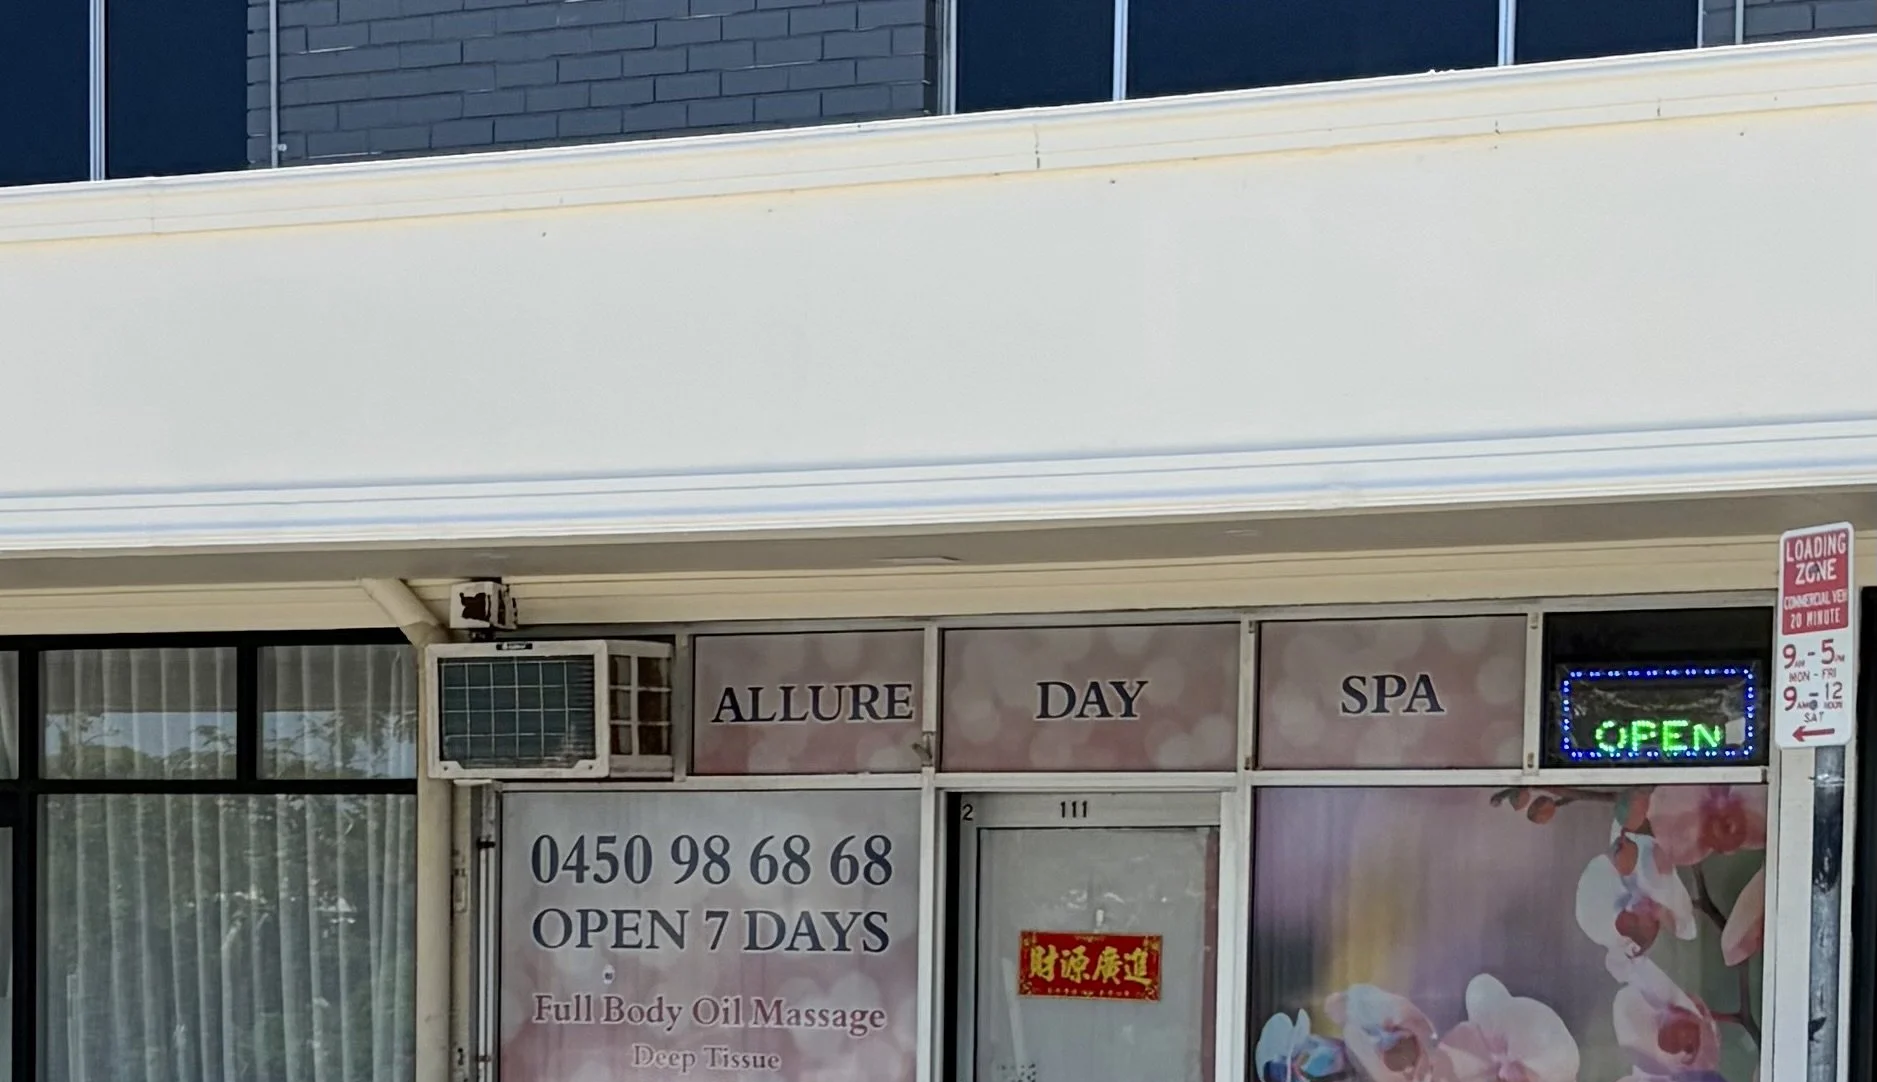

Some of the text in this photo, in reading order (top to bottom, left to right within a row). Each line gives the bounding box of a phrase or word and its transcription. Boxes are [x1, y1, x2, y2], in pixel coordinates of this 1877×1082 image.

[1786, 532, 1847, 562] LOADING
[1794, 558, 1838, 585] ZONE
[1790, 607, 1841, 629] 20 MINUTE
[1789, 670, 1811, 683] MON
[1822, 667, 1837, 680] FRI
[711, 673, 1446, 724] ALLURE DAY SPA
[1824, 681, 1843, 700] 12
[1803, 711, 1825, 723] SAT
[1594, 719, 1721, 752] OPEN
[962, 803, 974, 821] 2
[1060, 800, 1089, 818] 111
[531, 834, 894, 887] 0450 98 68 68
[532, 907, 891, 954] OPEN 7 DAYS
[1029, 943, 1152, 984] 財源廣進
[534, 994, 887, 1037] Full Body Oil Massage
[632, 1044, 781, 1073] Deep Tissue
